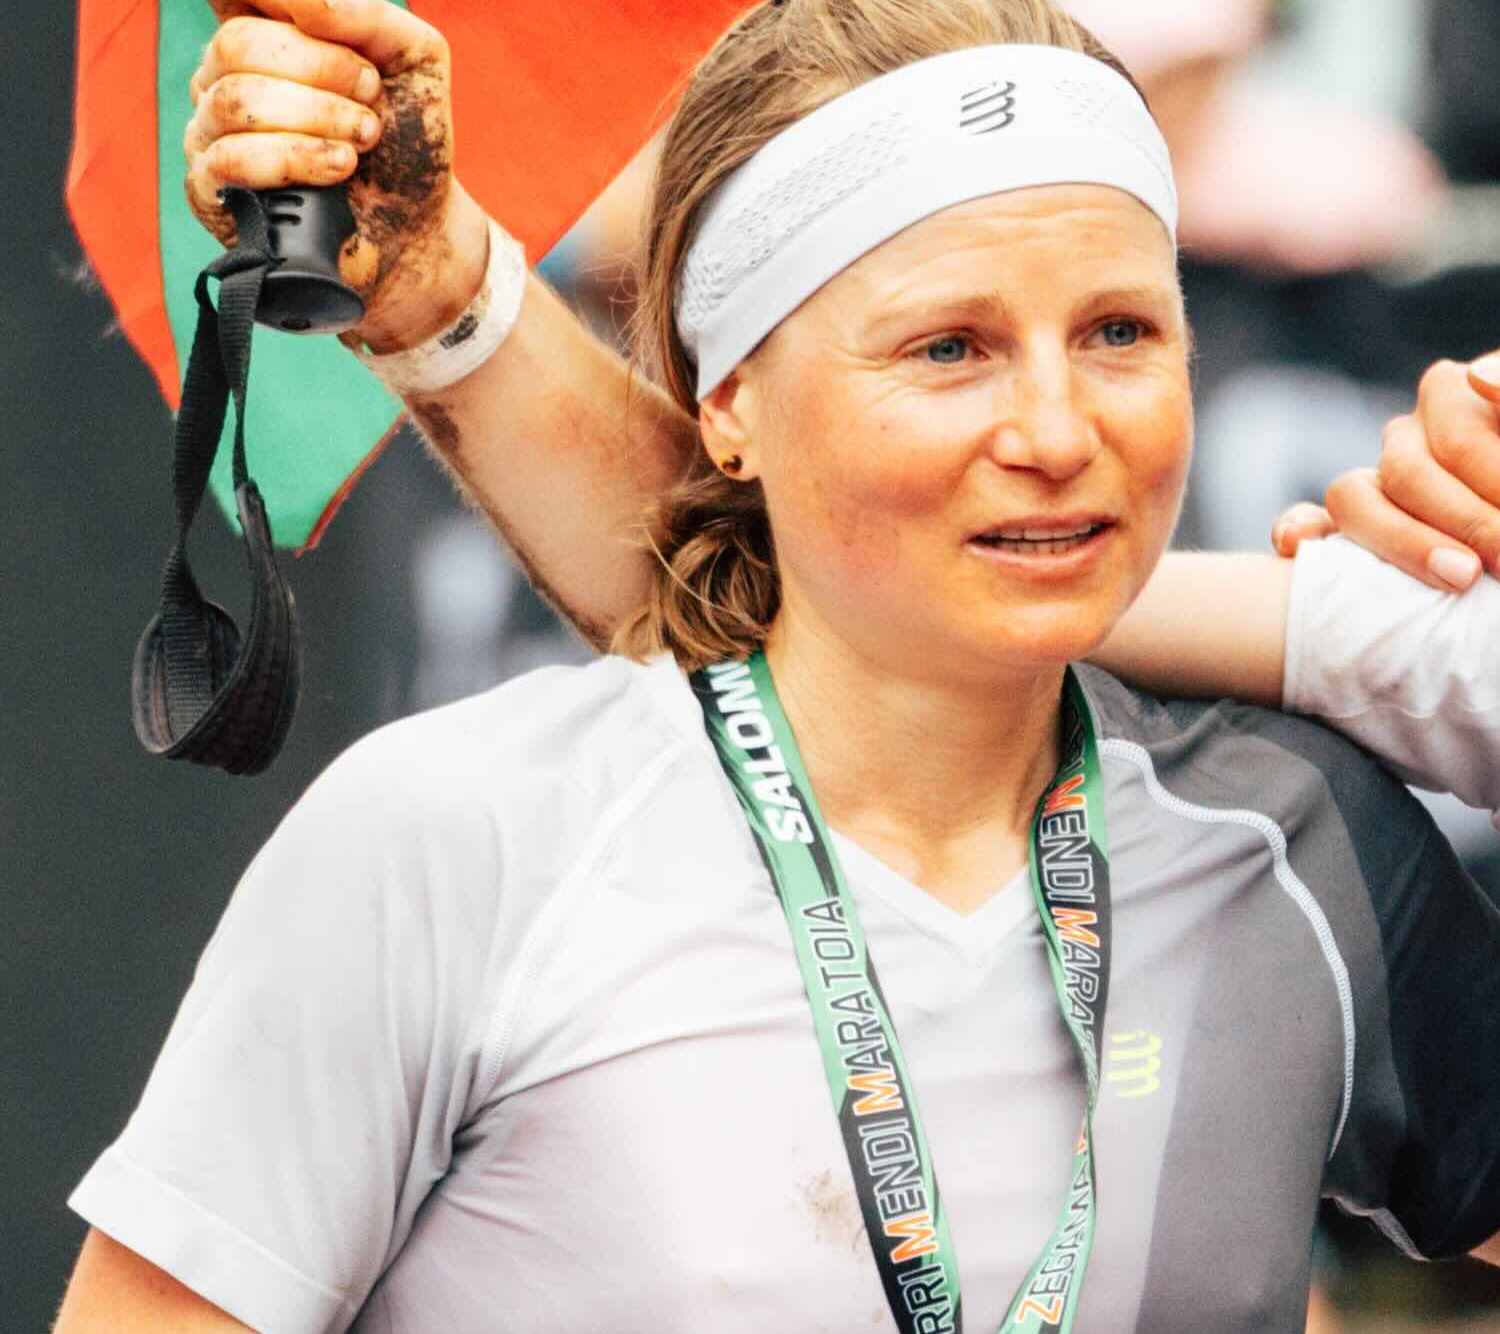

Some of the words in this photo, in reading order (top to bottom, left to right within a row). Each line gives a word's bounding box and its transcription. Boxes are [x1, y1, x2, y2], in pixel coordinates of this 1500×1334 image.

[706, 661, 816, 844] SALOM
[798, 896, 906, 1118] MARATOIA
[853, 1113, 940, 1265] MENDI
